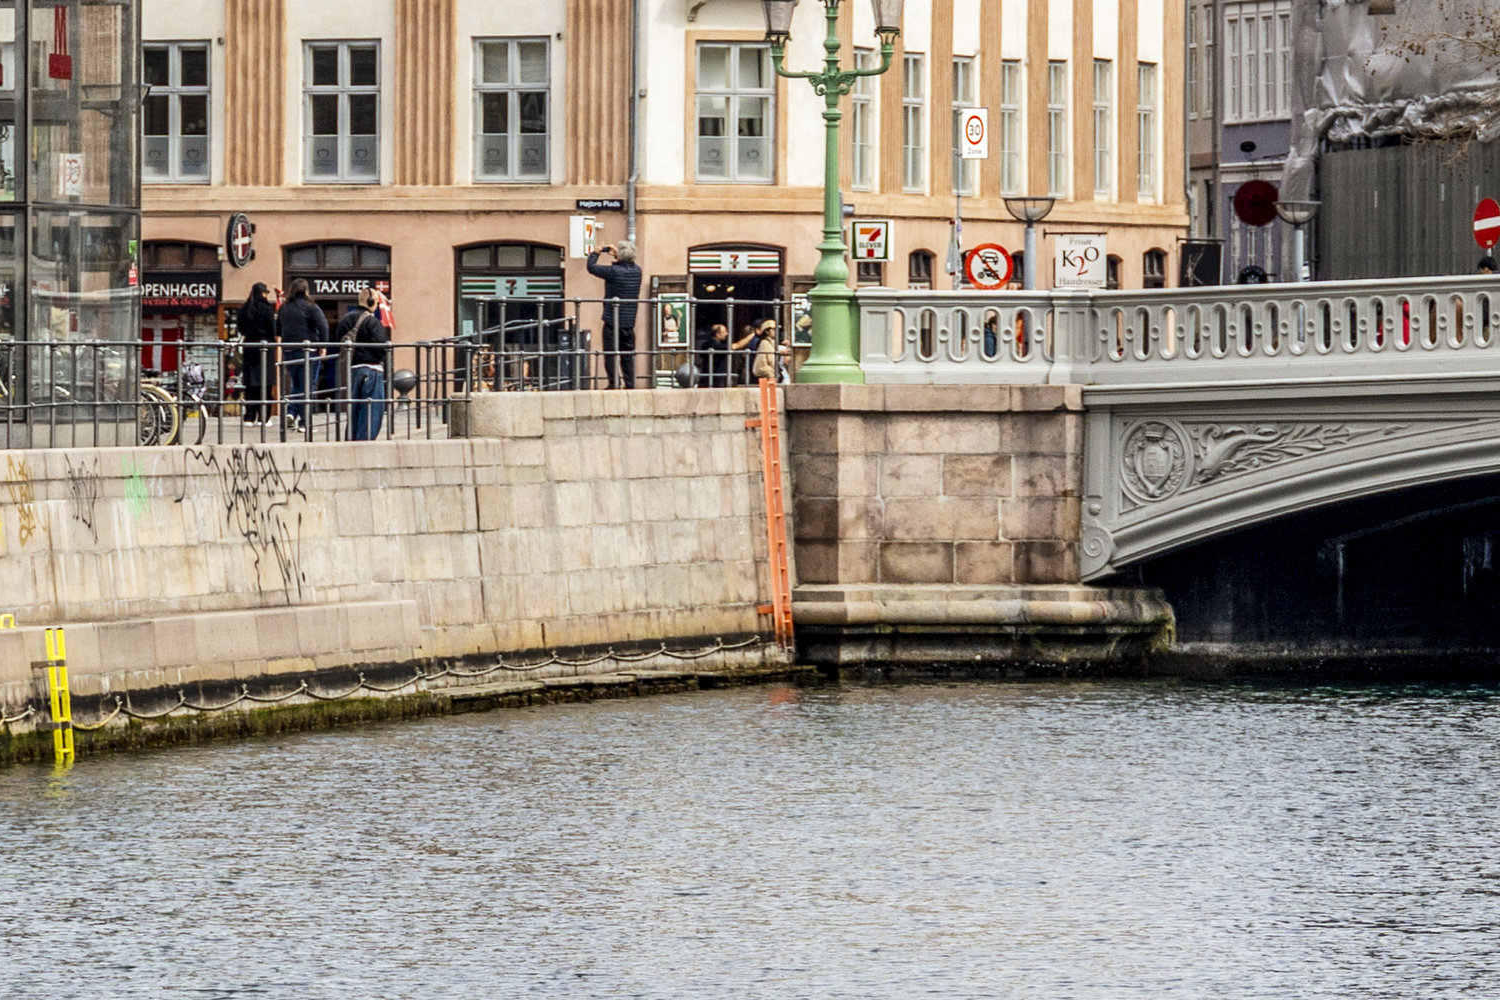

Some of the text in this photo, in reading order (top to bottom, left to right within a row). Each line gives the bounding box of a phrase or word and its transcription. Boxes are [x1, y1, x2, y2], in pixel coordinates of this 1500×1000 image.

[969, 124, 980, 136] 30
[860, 227, 881, 258] 7
[314, 280, 369, 293] TAX FREE
